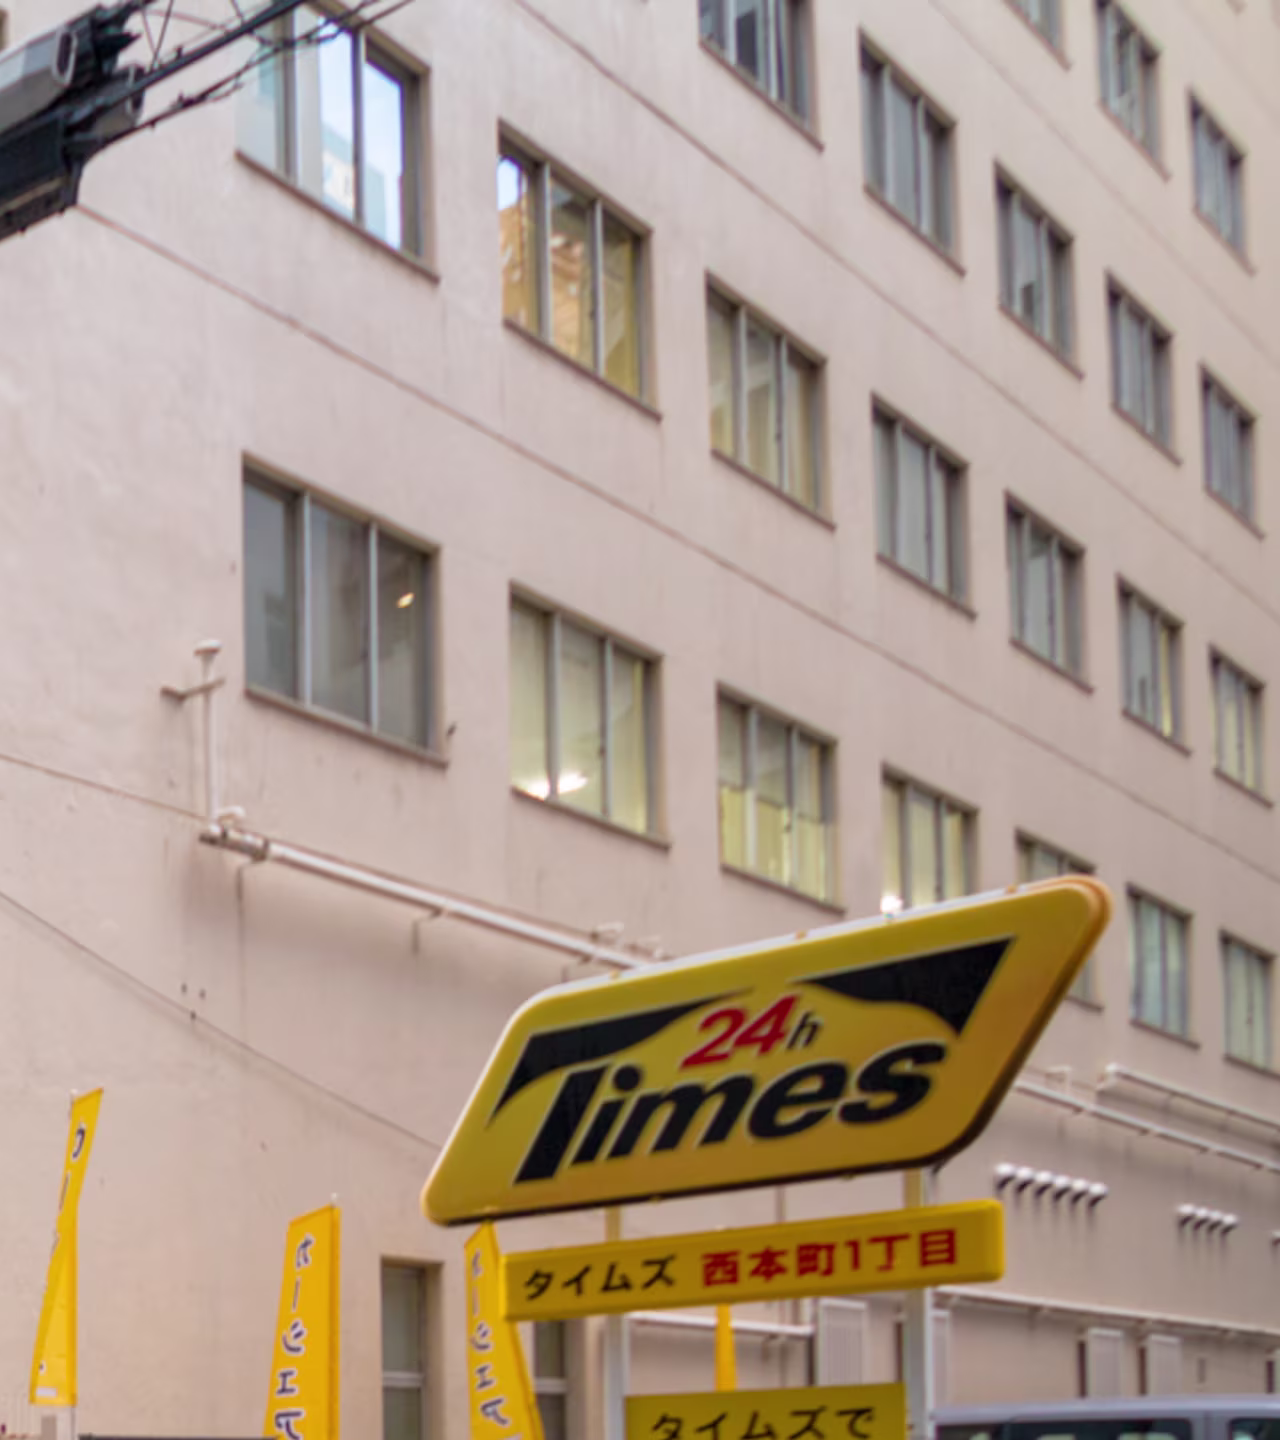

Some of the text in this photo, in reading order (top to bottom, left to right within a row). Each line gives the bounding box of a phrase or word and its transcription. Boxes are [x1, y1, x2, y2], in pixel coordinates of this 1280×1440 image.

[488, 1000, 952, 1186] Times
[523, 1227, 958, 1301] タイムズ 西本町1丁目
